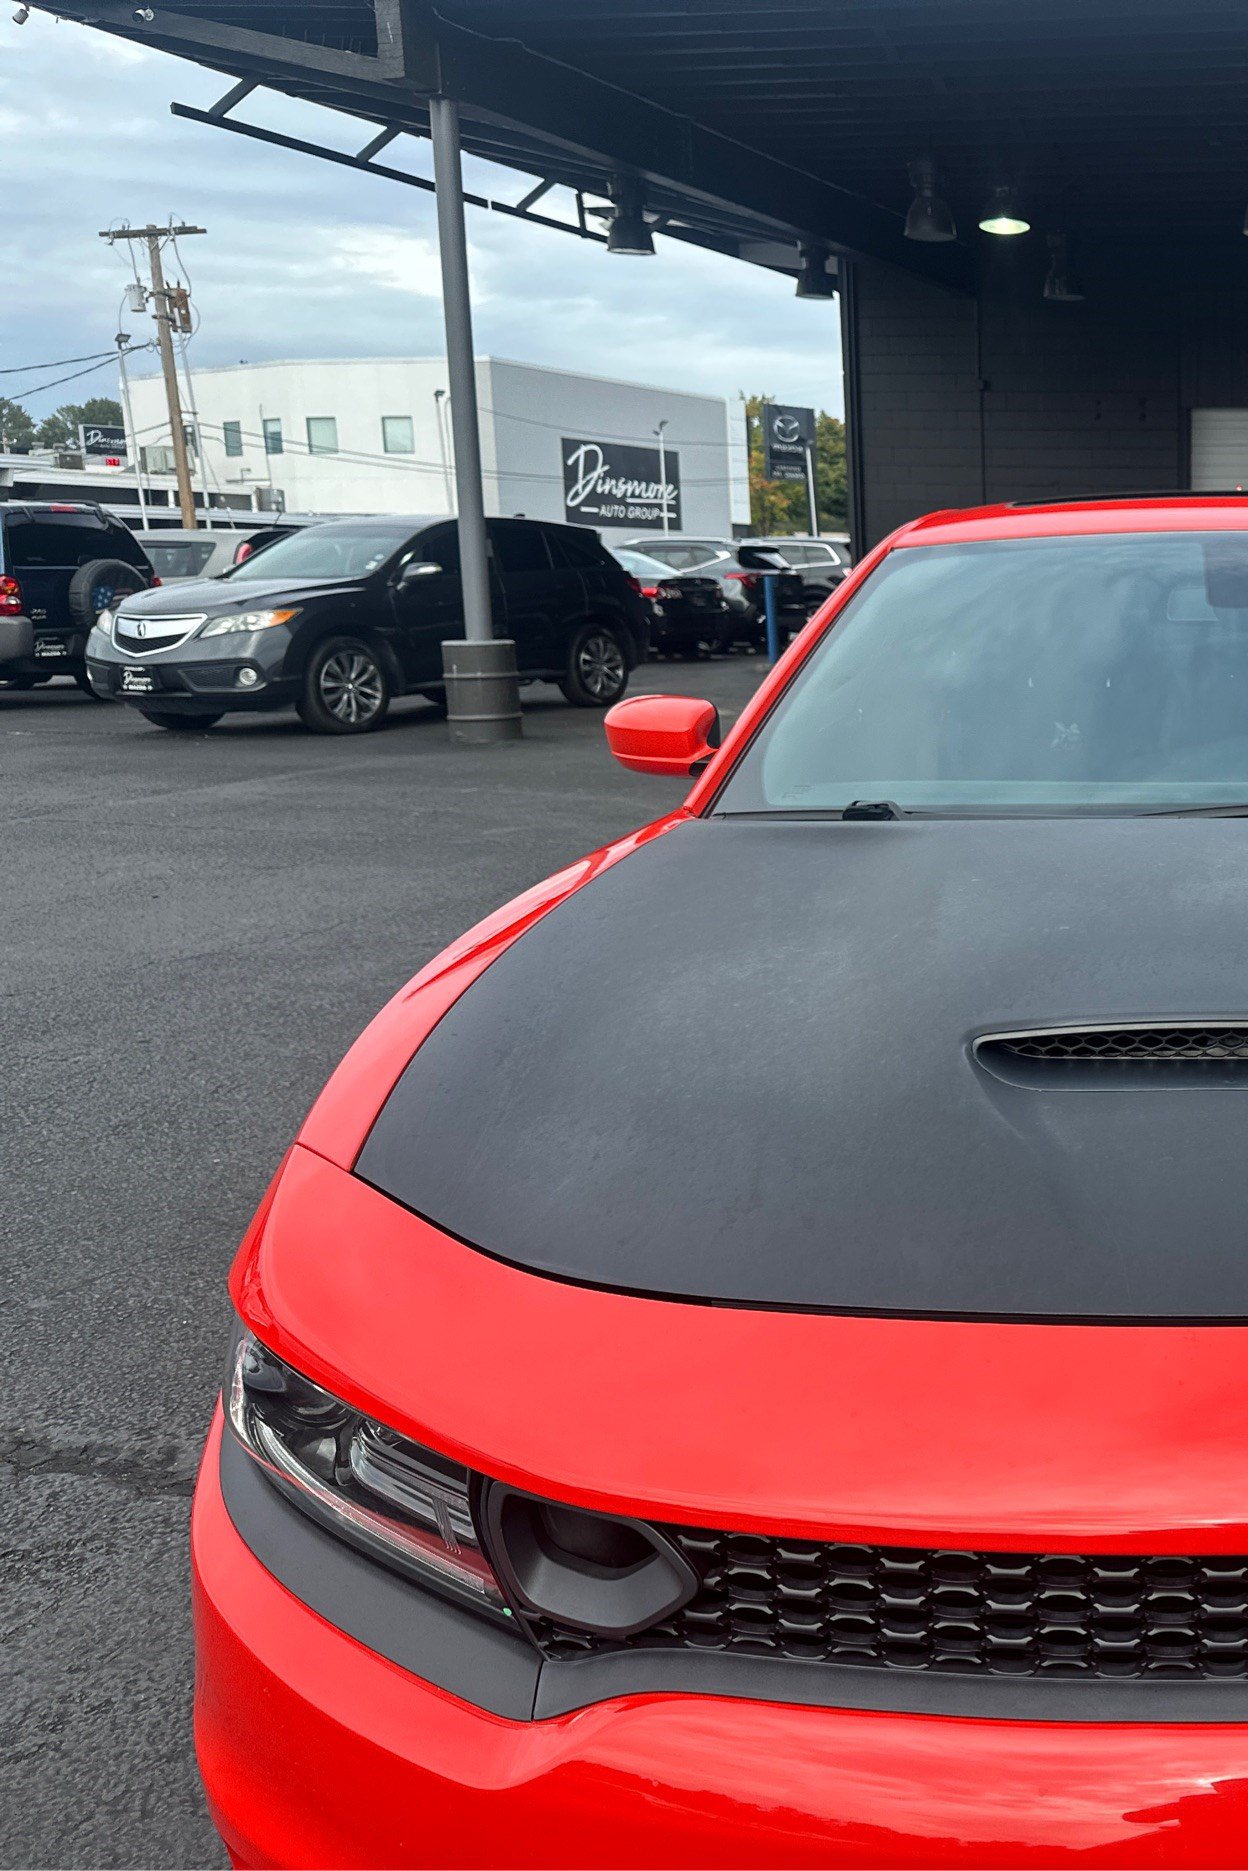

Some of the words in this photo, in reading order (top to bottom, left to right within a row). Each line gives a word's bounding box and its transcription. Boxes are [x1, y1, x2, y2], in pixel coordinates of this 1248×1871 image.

[566, 444, 678, 507] Dinsmore
[600, 505, 626, 518] AUTO
[627, 506, 660, 520] GROUP
